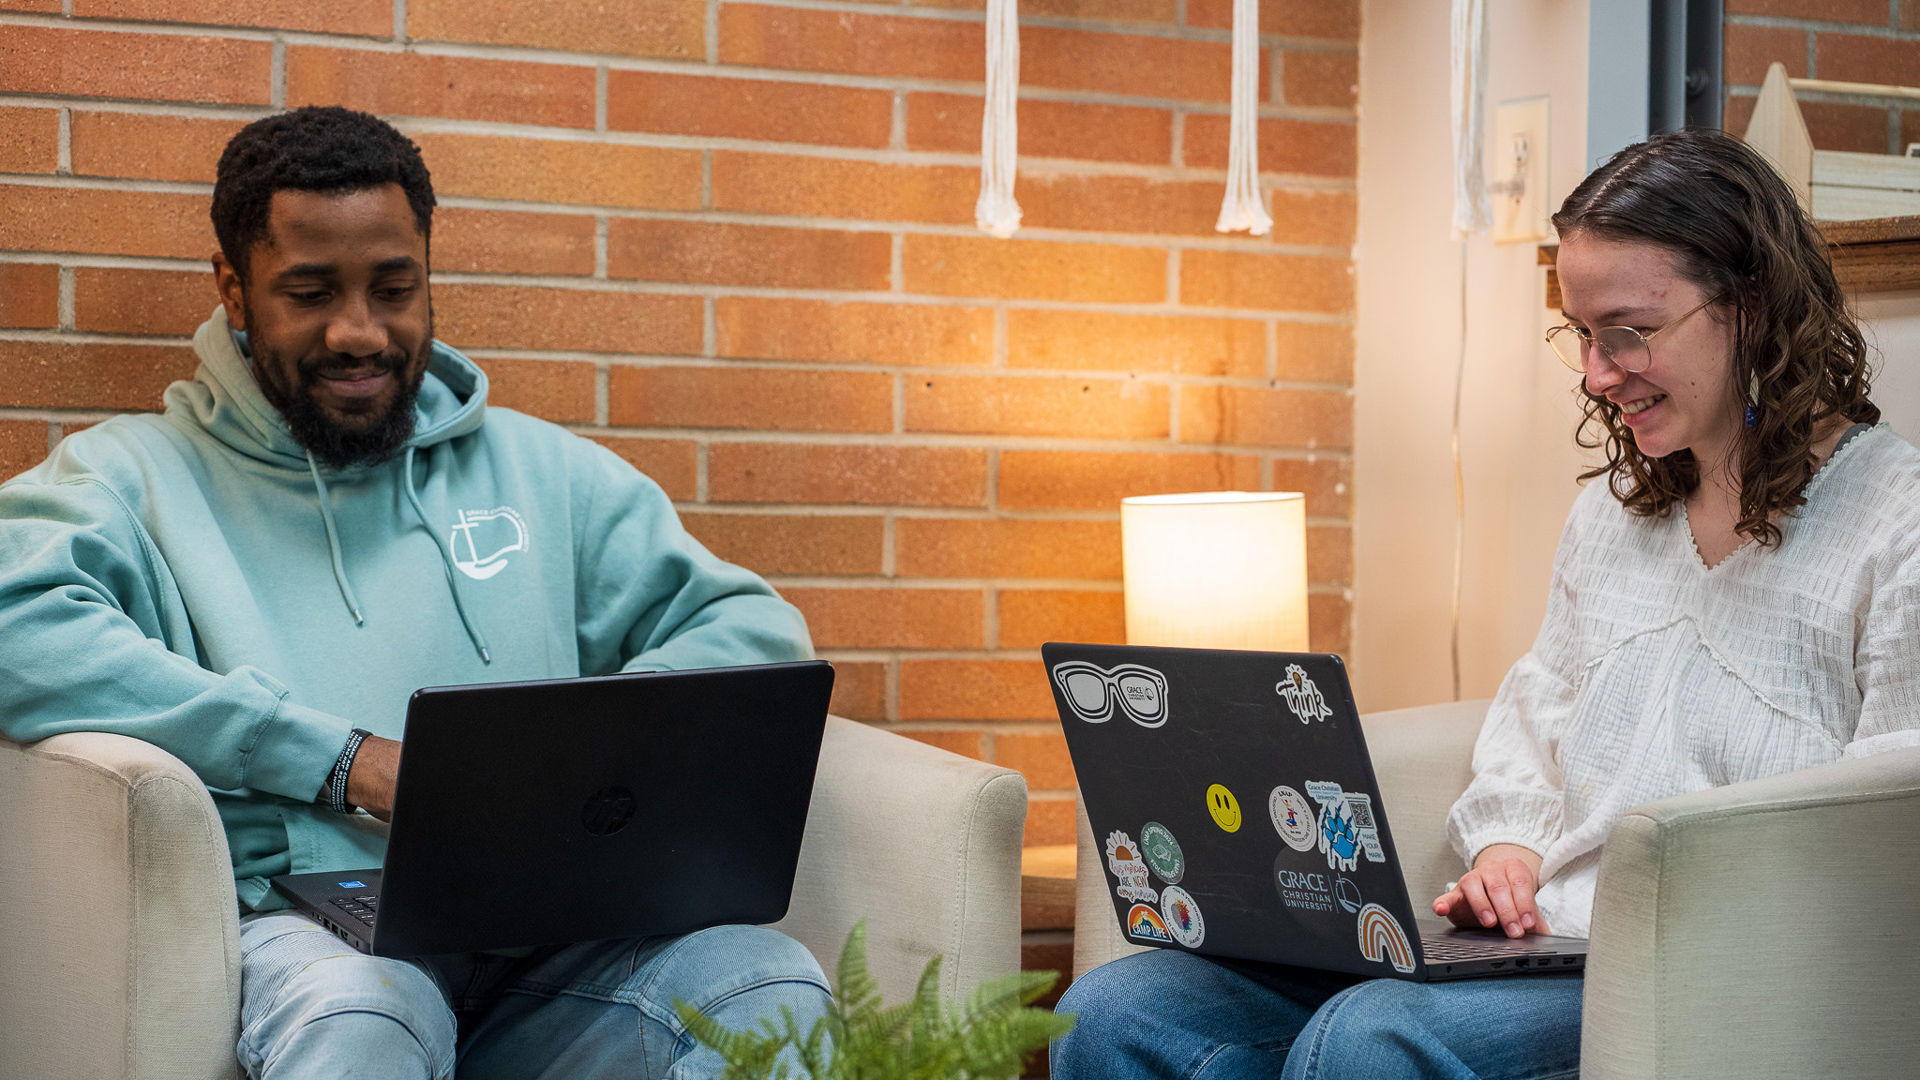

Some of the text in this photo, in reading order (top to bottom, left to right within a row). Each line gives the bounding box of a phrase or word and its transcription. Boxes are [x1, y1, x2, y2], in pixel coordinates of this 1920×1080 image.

[1127, 686, 1143, 694] GRACE
[1278, 682, 1331, 721] Think
[1278, 870, 1328, 892] GRACE
[1282, 889, 1331, 903] CHRISTIAN
[1284, 899, 1333, 912] UNIVERSITY
[1132, 923, 1167, 939] CAMP LIFE
